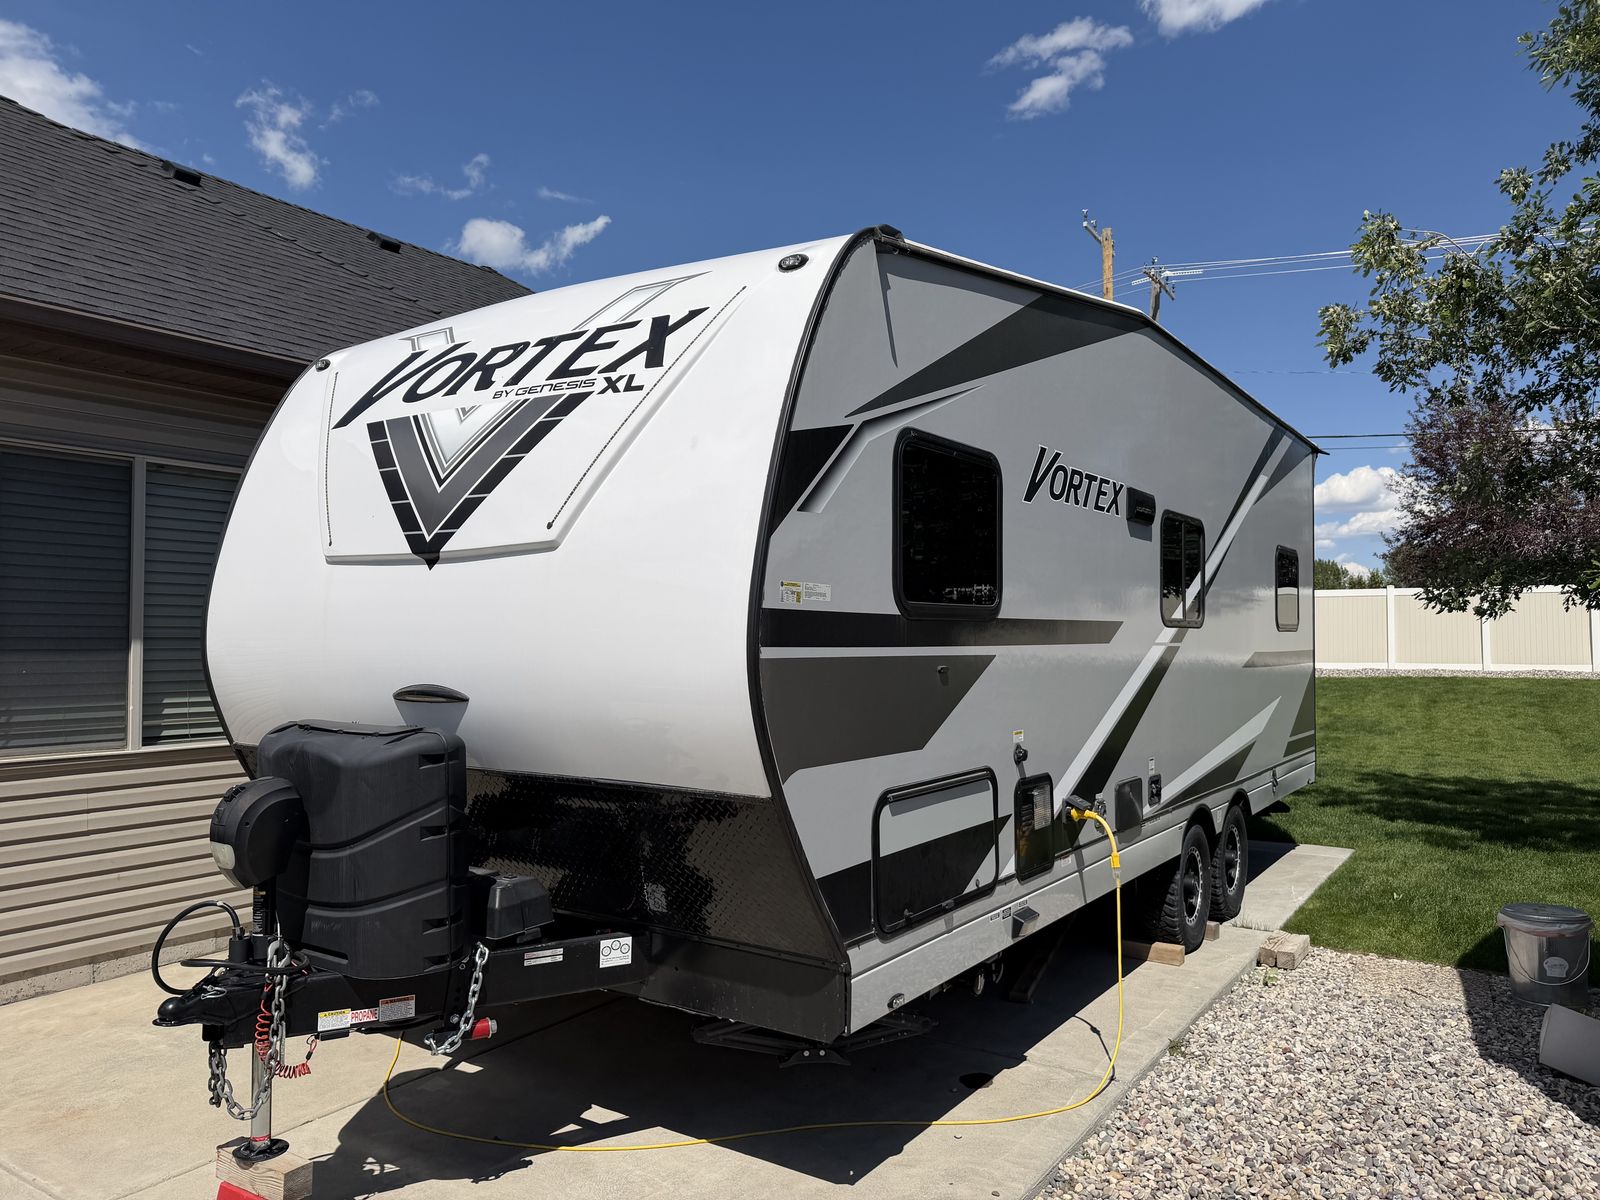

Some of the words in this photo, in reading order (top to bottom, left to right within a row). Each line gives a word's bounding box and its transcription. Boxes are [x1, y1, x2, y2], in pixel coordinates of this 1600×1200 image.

[331, 306, 710, 430] VORTEX
[492, 387, 514, 400] BY
[515, 378, 596, 397] GENESIS
[597, 374, 645, 395] XL
[1023, 445, 1125, 517] VORTEX
[351, 1008, 378, 1022] PROPANE
